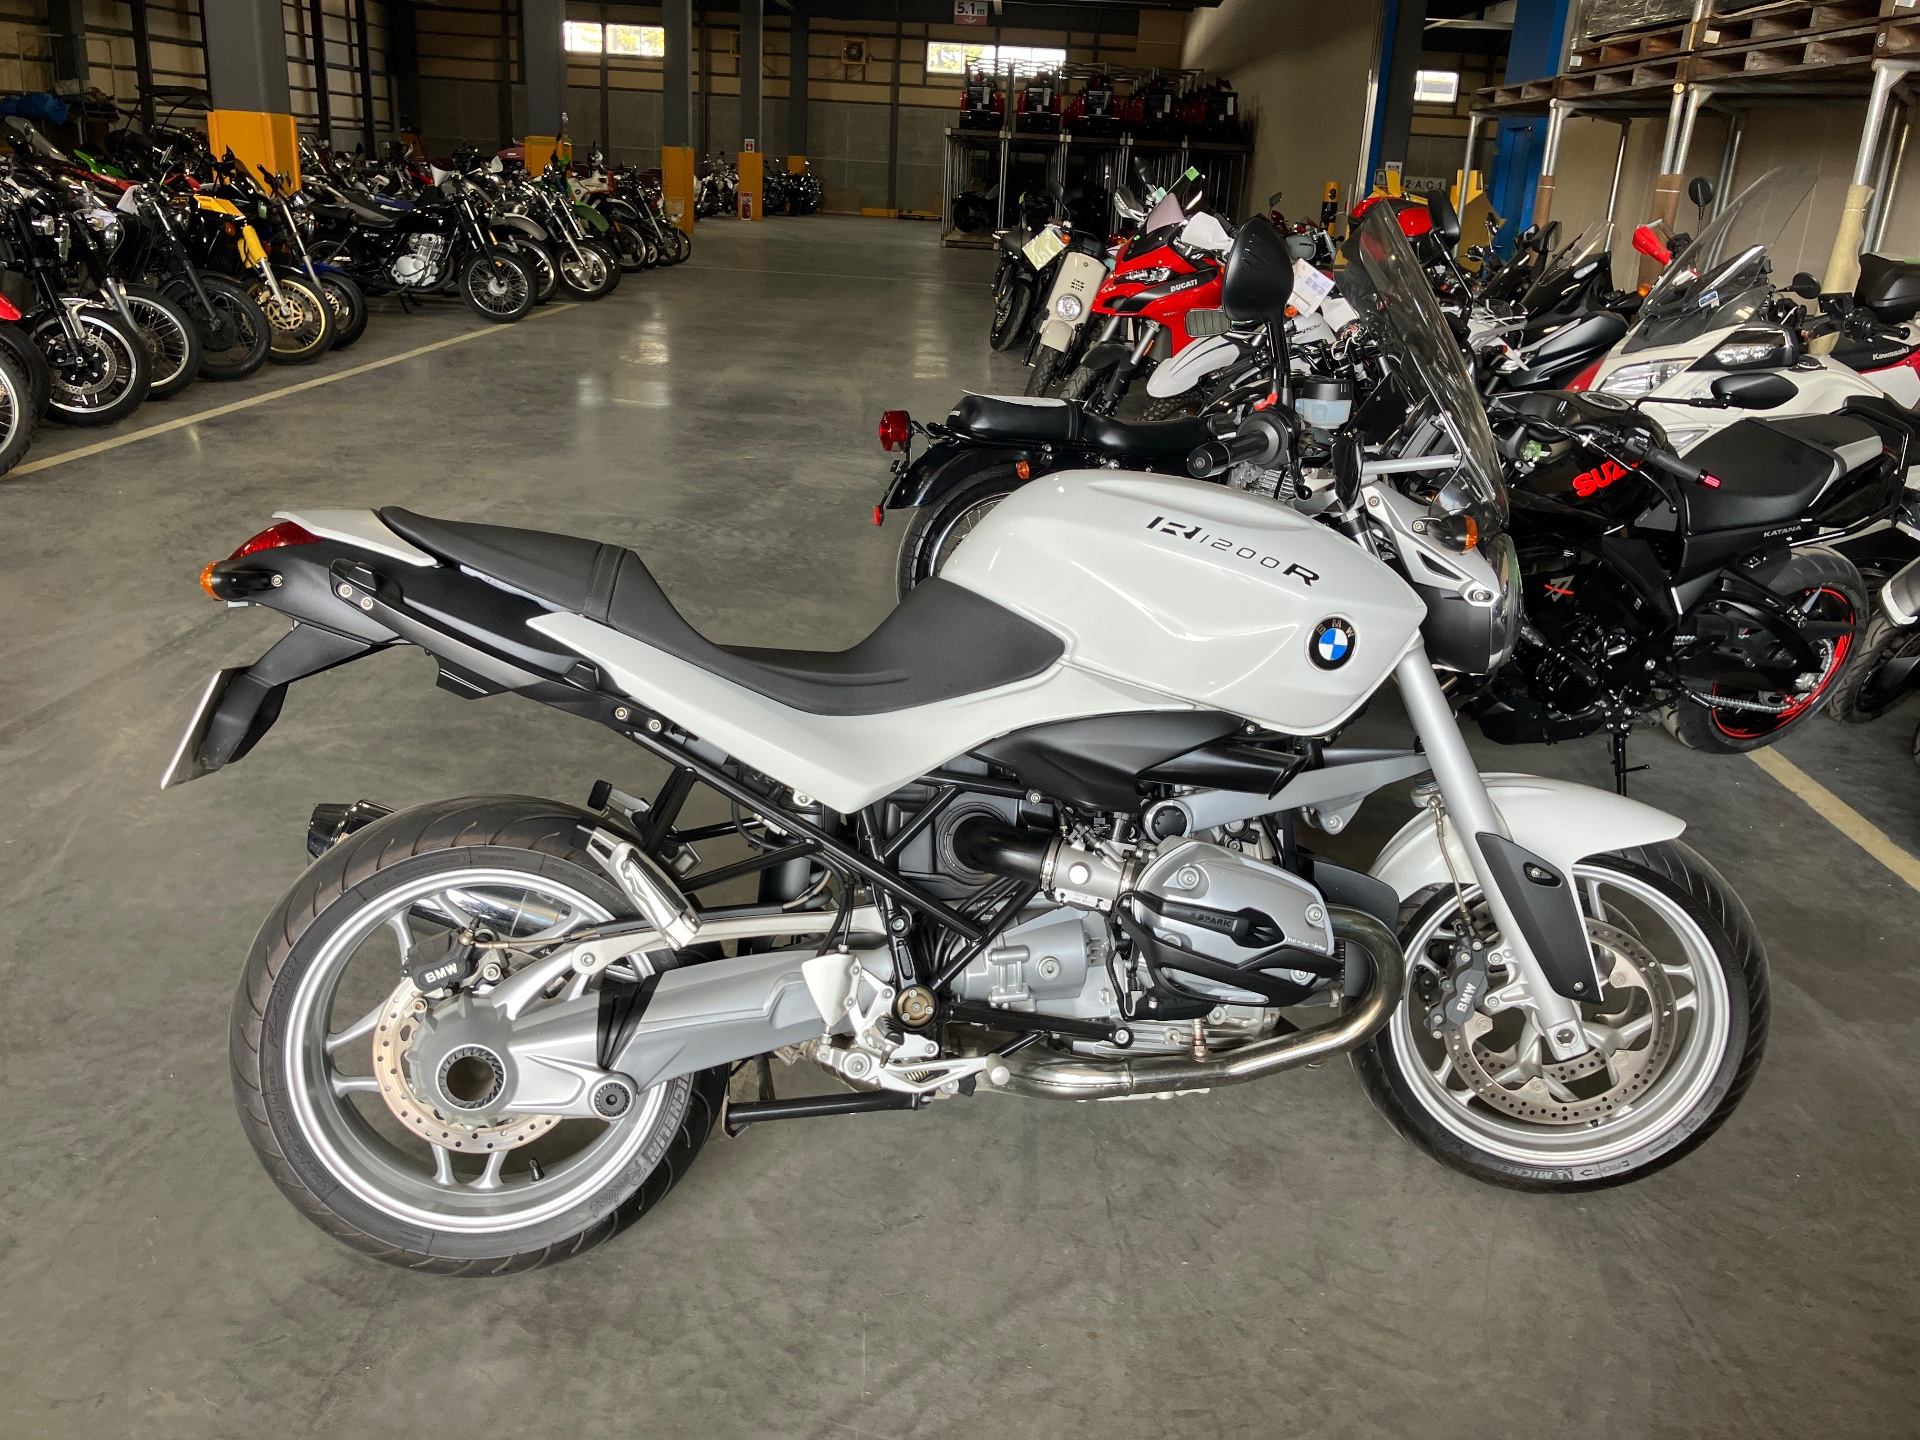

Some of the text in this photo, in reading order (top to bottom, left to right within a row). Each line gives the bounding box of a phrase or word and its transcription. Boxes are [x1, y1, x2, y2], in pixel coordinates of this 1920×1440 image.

[1170, 279, 1198, 292] DUCATI
[1872, 346, 1909, 360] Kawasaki
[1573, 460, 1640, 497] SUZ
[1763, 525, 1801, 538] KATANA
[1315, 619, 1355, 638] BMW
[1199, 912, 1231, 928] SPARK
[424, 962, 458, 983] BMW
[1456, 982, 1477, 1013] BMW
